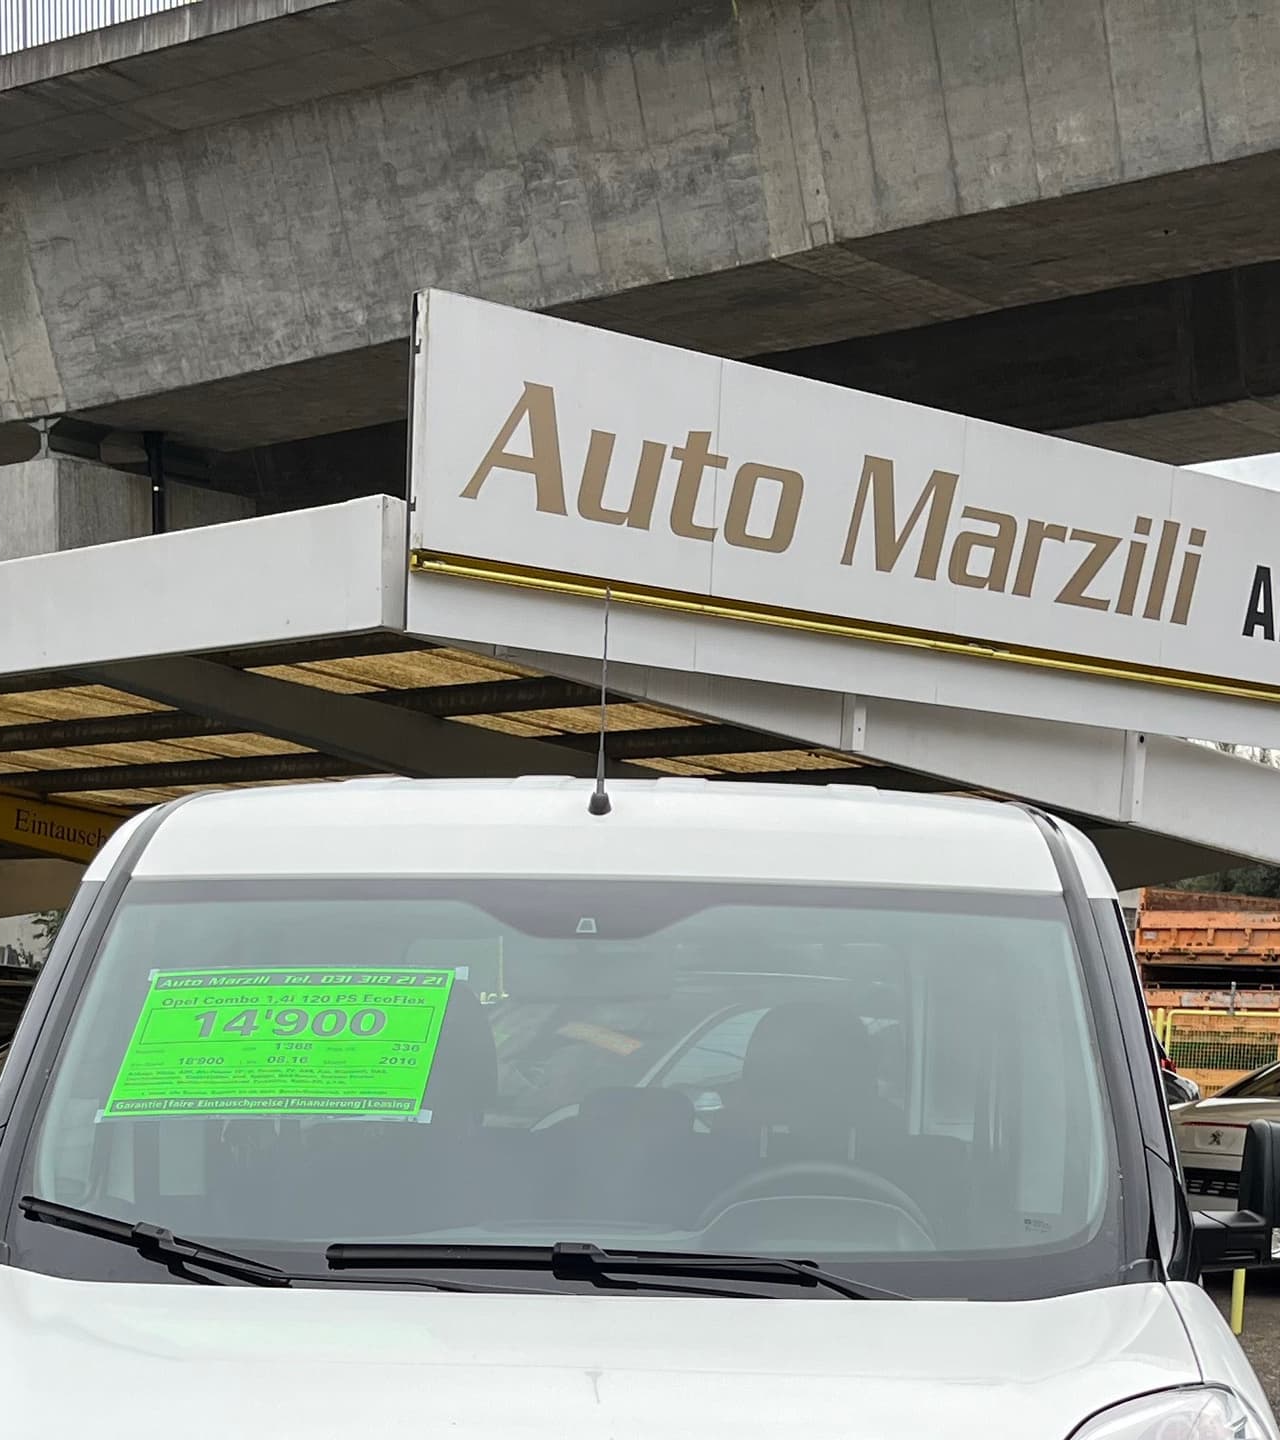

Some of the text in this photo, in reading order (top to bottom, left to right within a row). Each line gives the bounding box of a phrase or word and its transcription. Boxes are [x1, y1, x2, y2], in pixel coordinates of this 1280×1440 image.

[459, 381, 1207, 626] Auto Marzili
[160, 977, 202, 987] Auto
[320, 975, 352, 984] 031
[359, 975, 390, 984] 318
[396, 975, 416, 985] 21
[423, 976, 443, 986] 21
[162, 997, 198, 1008] Opel
[204, 995, 259, 1005] Combo
[302, 994, 330, 1003] 120
[336, 994, 357, 1003] PS
[194, 1008, 387, 1039] 14'900
